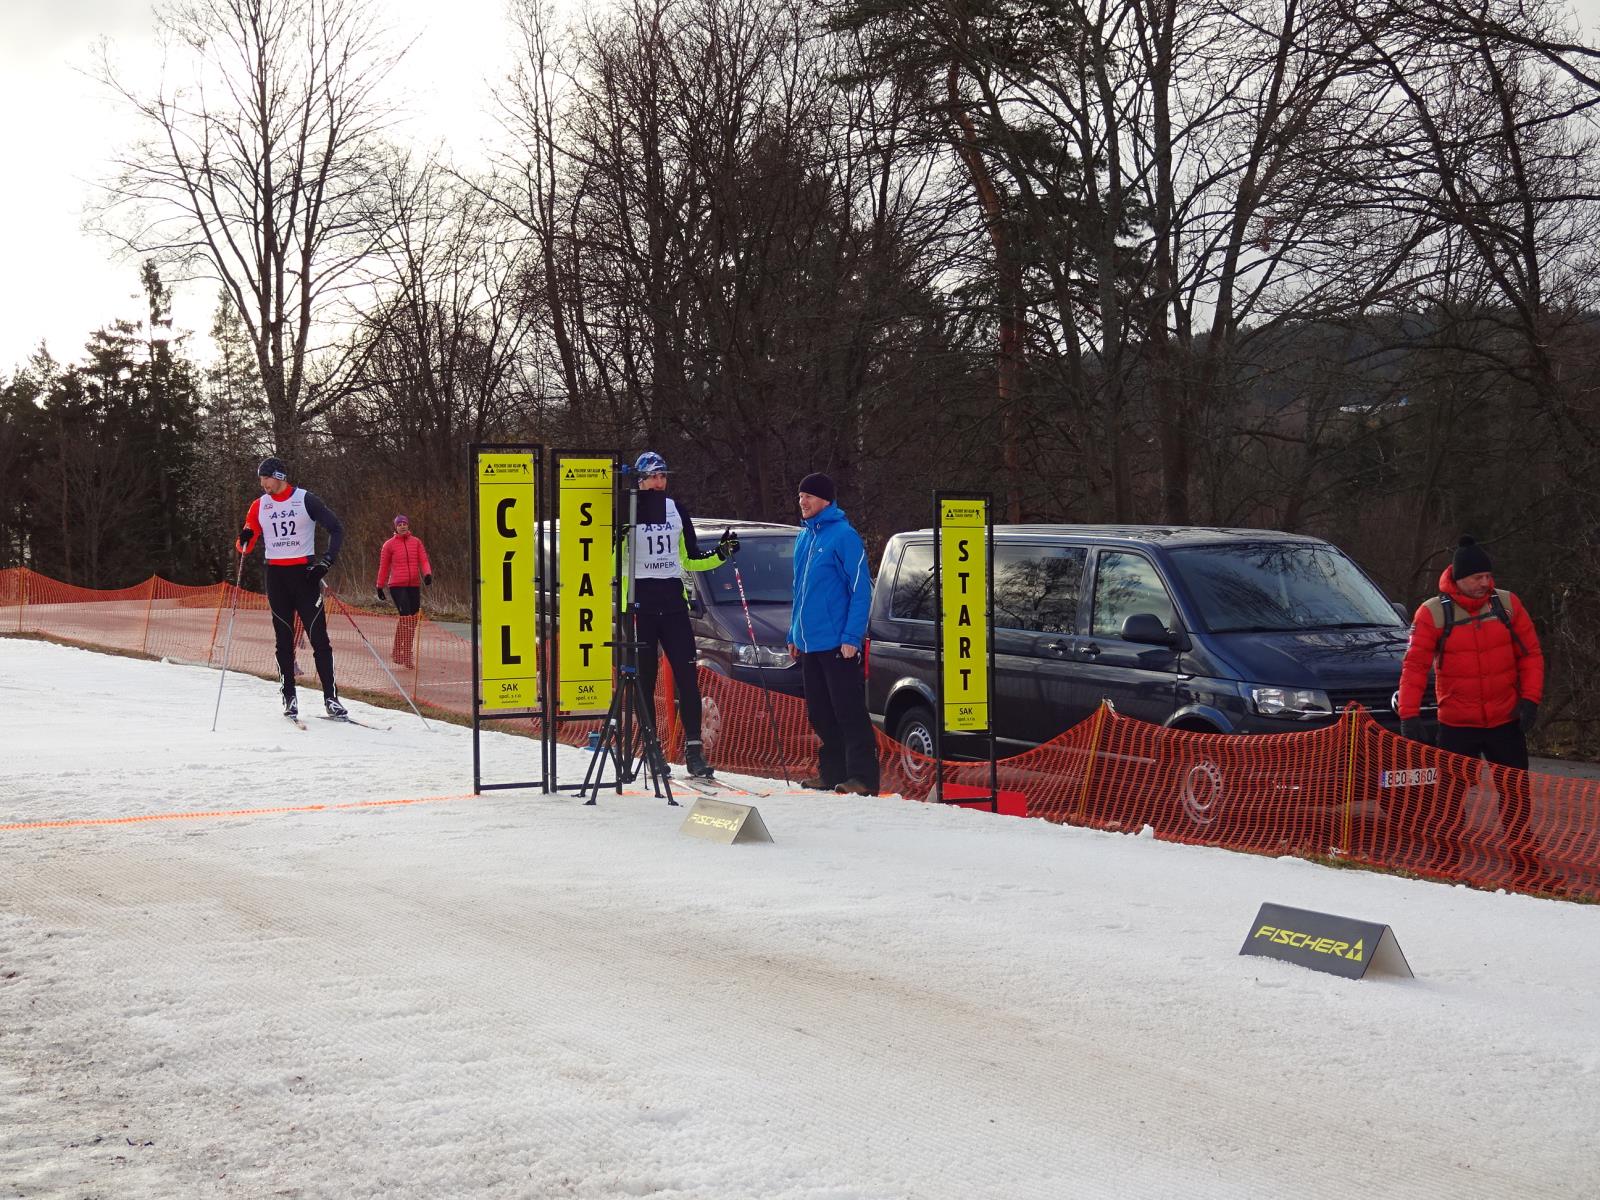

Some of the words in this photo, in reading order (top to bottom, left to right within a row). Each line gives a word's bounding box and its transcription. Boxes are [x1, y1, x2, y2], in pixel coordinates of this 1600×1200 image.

[272, 520, 297, 537] 152
[271, 540, 301, 548] VIMPERK
[646, 534, 672, 555] 151
[496, 497, 521, 665] CÍL
[578, 502, 594, 667] START
[958, 539, 972, 691] START
[501, 683, 518, 692] SAK
[578, 685, 594, 694] SAK
[959, 707, 973, 715] SAK
[687, 813, 732, 829] FISCHER
[1254, 925, 1349, 957] FISCHER
